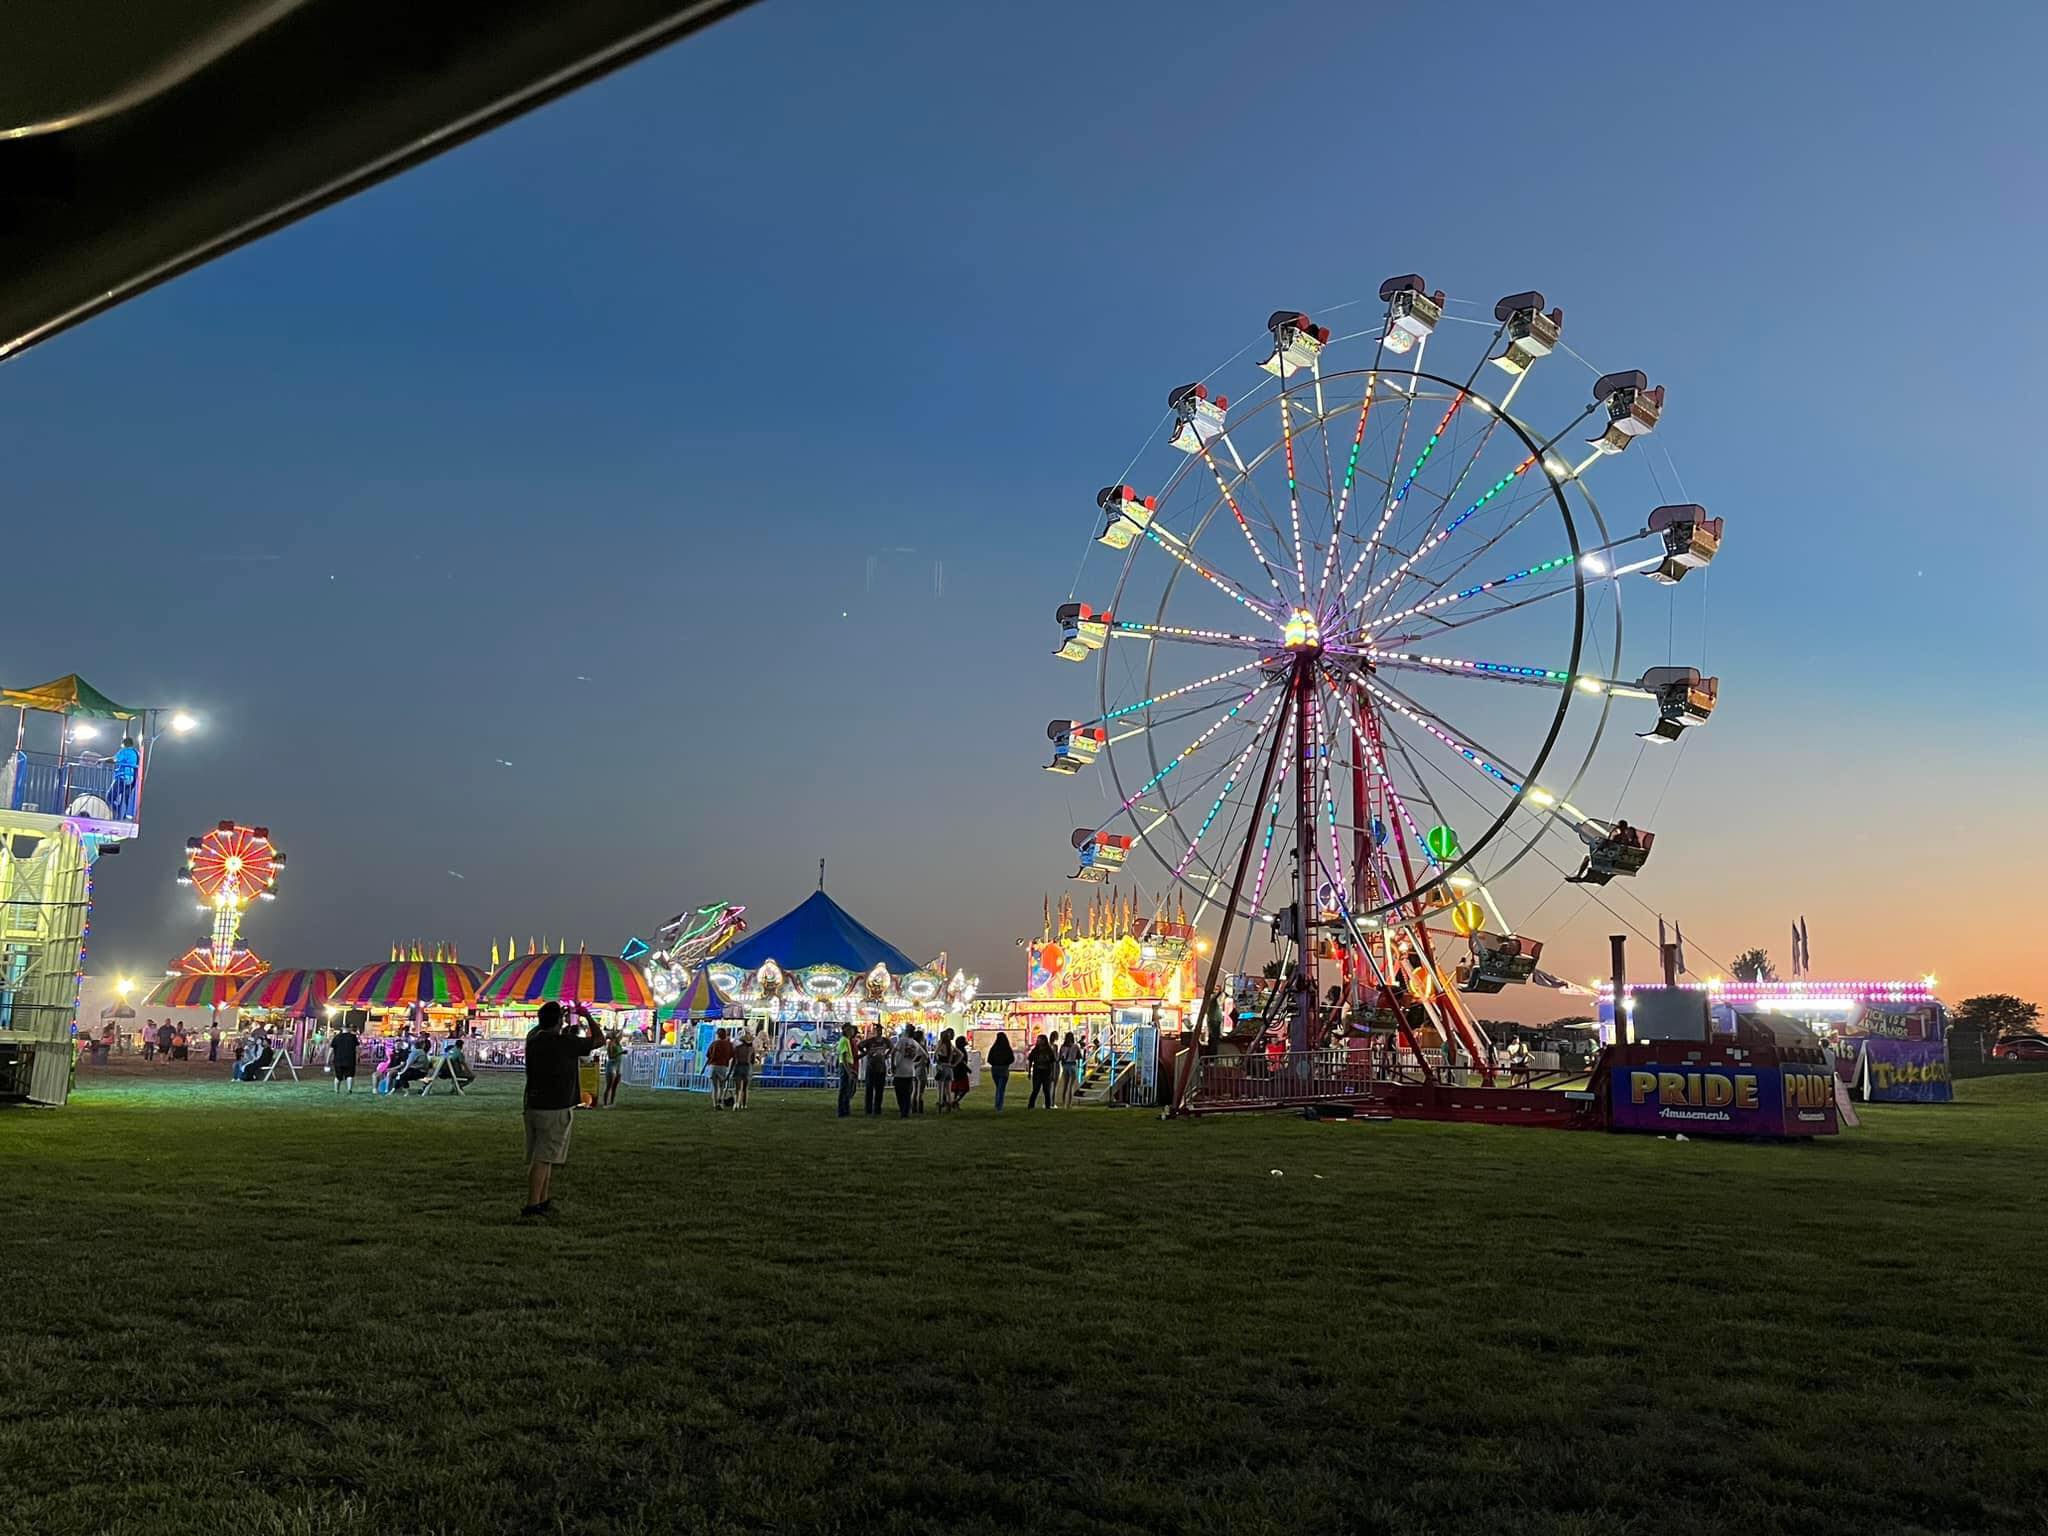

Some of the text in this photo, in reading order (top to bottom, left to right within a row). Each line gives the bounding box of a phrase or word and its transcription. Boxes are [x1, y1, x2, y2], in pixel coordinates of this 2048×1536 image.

[1630, 1071, 1760, 1109] PRIDE
[1784, 1073, 1834, 1107] PRIDE
[1659, 1107, 1730, 1121] Amusements
